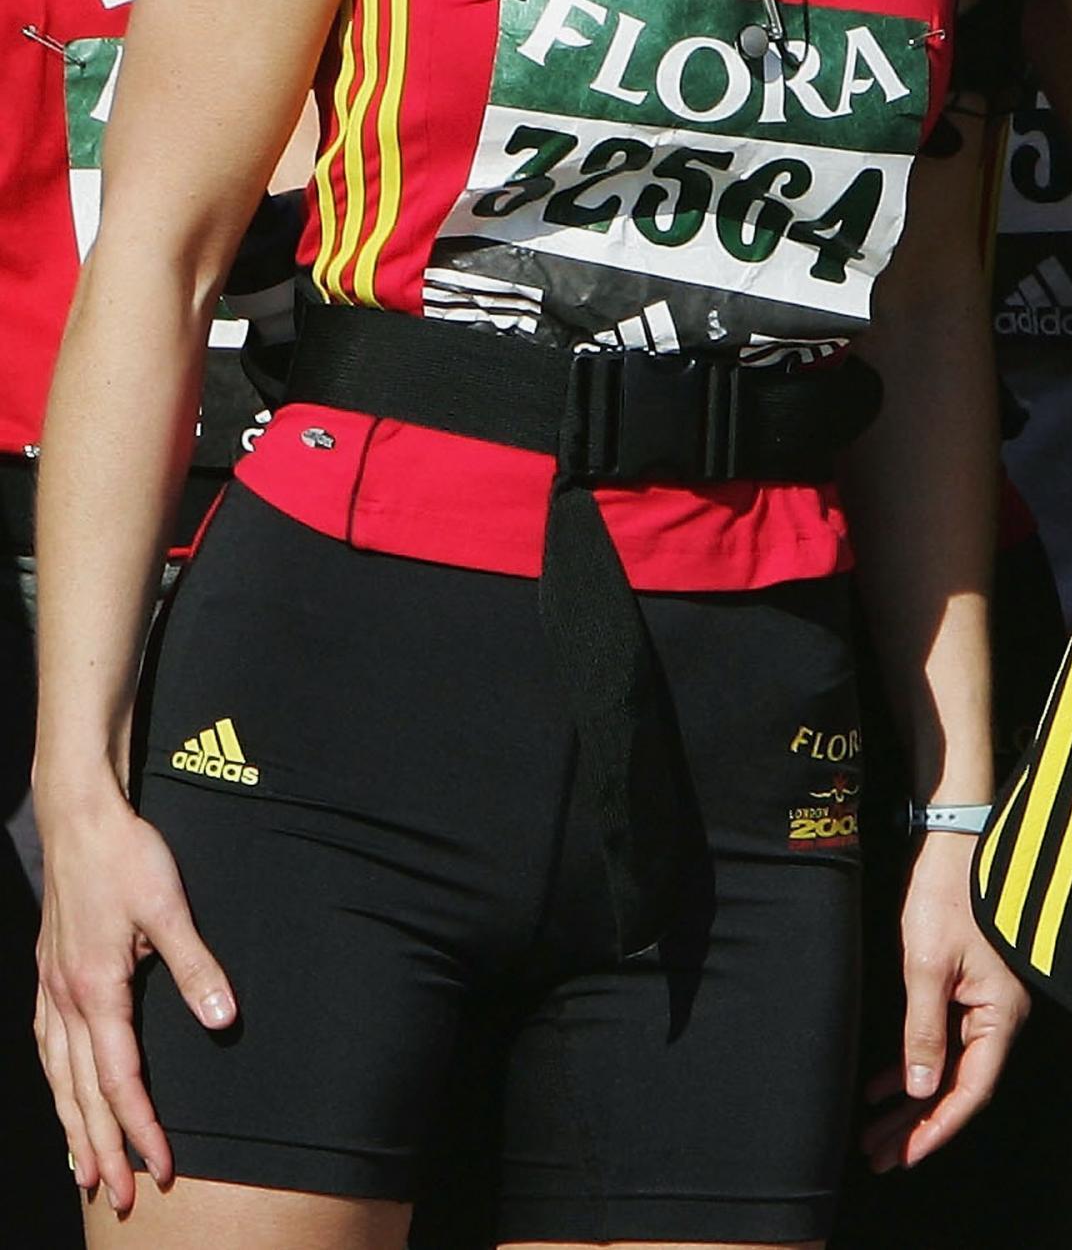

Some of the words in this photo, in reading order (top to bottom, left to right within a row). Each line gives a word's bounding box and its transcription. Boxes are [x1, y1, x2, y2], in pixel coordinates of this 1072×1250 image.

[472, 125, 884, 284] 32564
[172, 750, 260, 786] adidas
[789, 815, 858, 839] 200
